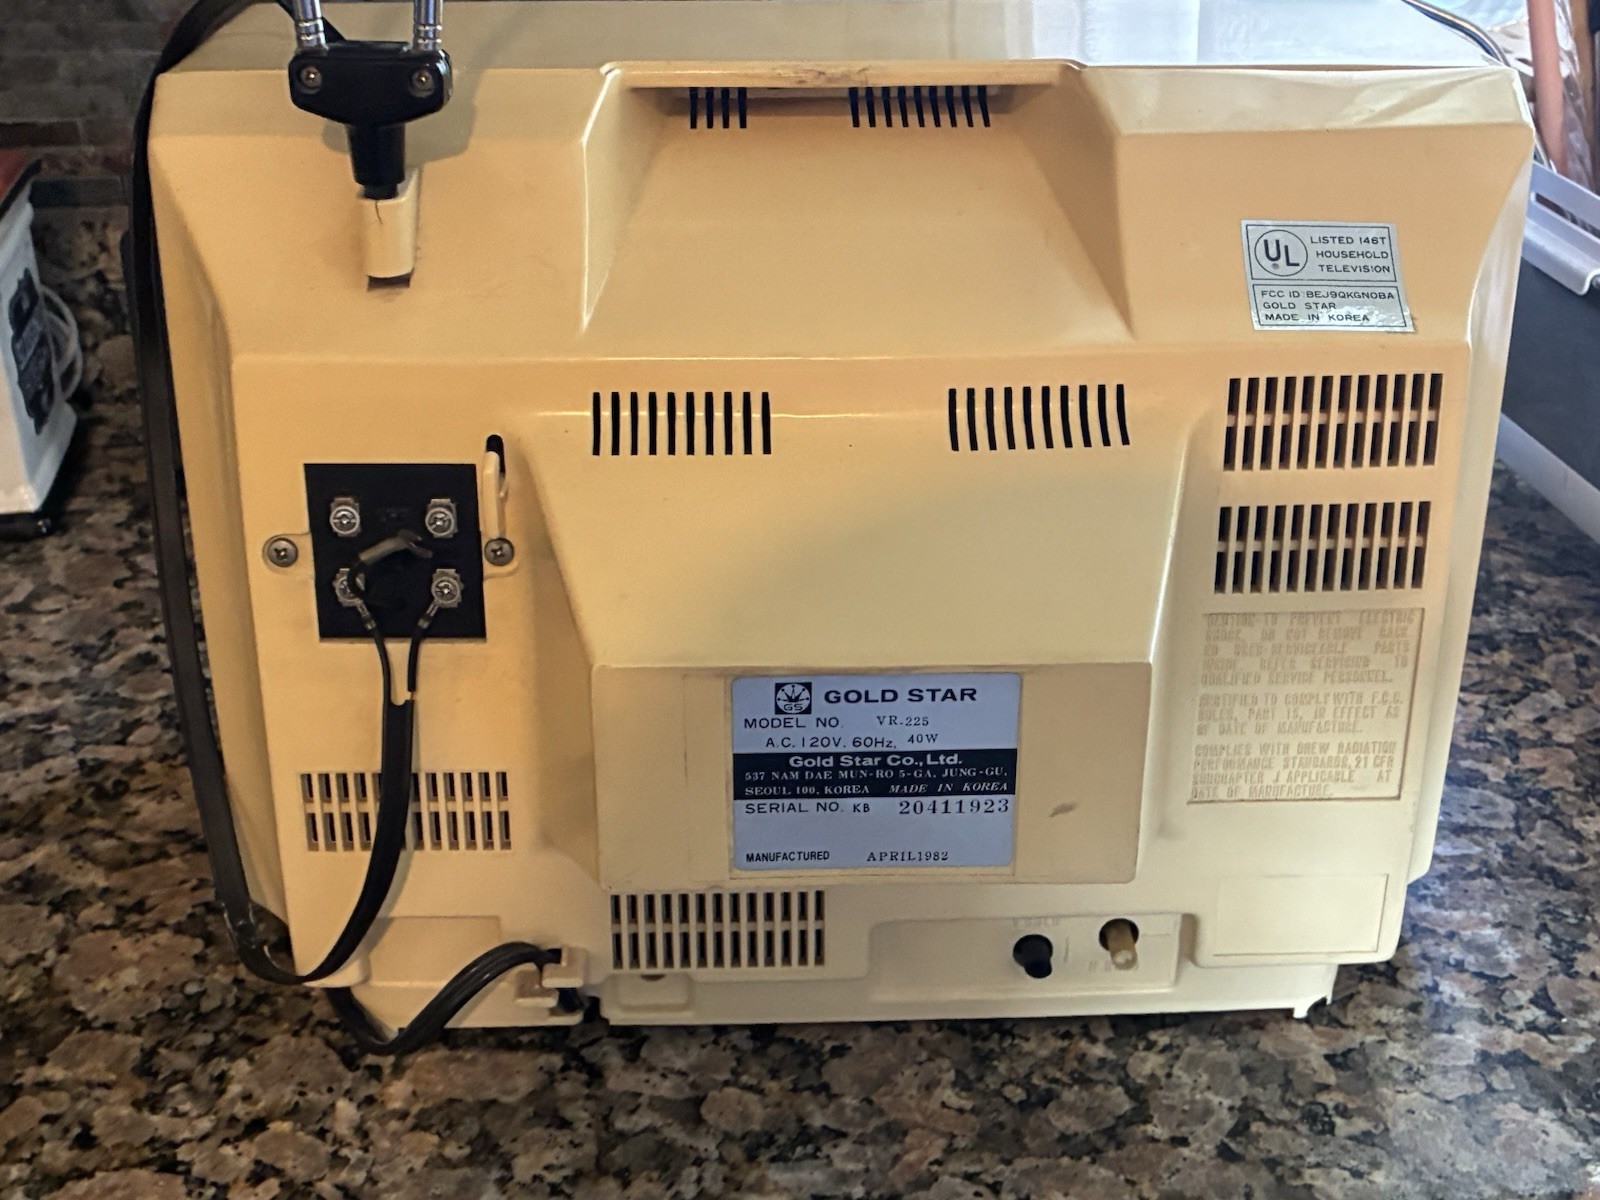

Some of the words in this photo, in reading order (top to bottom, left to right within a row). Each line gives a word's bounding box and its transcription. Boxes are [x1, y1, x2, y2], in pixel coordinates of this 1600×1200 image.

[1310, 236, 1354, 245] LISTED
[1264, 239, 1300, 267] UL
[1318, 265, 1390, 273] TELEVISION
[1261, 290, 1284, 298] FCC
[1305, 302, 1336, 310] STAR
[1265, 313, 1299, 321] MADE
[1328, 314, 1369, 322] KOREA
[824, 689, 898, 704] GOLD
[908, 688, 978, 702] STAR
[744, 718, 806, 729] MODEL
[816, 717, 844, 728] NO.
[766, 737, 795, 748] A.C.
[908, 734, 939, 744] 40W
[789, 756, 834, 768] Gold
[840, 755, 881, 767] Star
[745, 772, 766, 782] 537
[772, 771, 799, 780] NAM
[805, 770, 832, 780] DAE
[838, 770, 894, 779] MUN-RO
[745, 786, 792, 796] SEOUL
[824, 784, 870, 794] KOREA
[889, 784, 928, 793] MADE
[938, 784, 953, 792] IN
[963, 782, 1008, 792] KOREA
[746, 802, 808, 814] SERIAL
[816, 802, 844, 812] NO.
[852, 802, 870, 813] KB
[900, 799, 1009, 815] 20411923
[746, 851, 830, 863] MANUFACTURED
